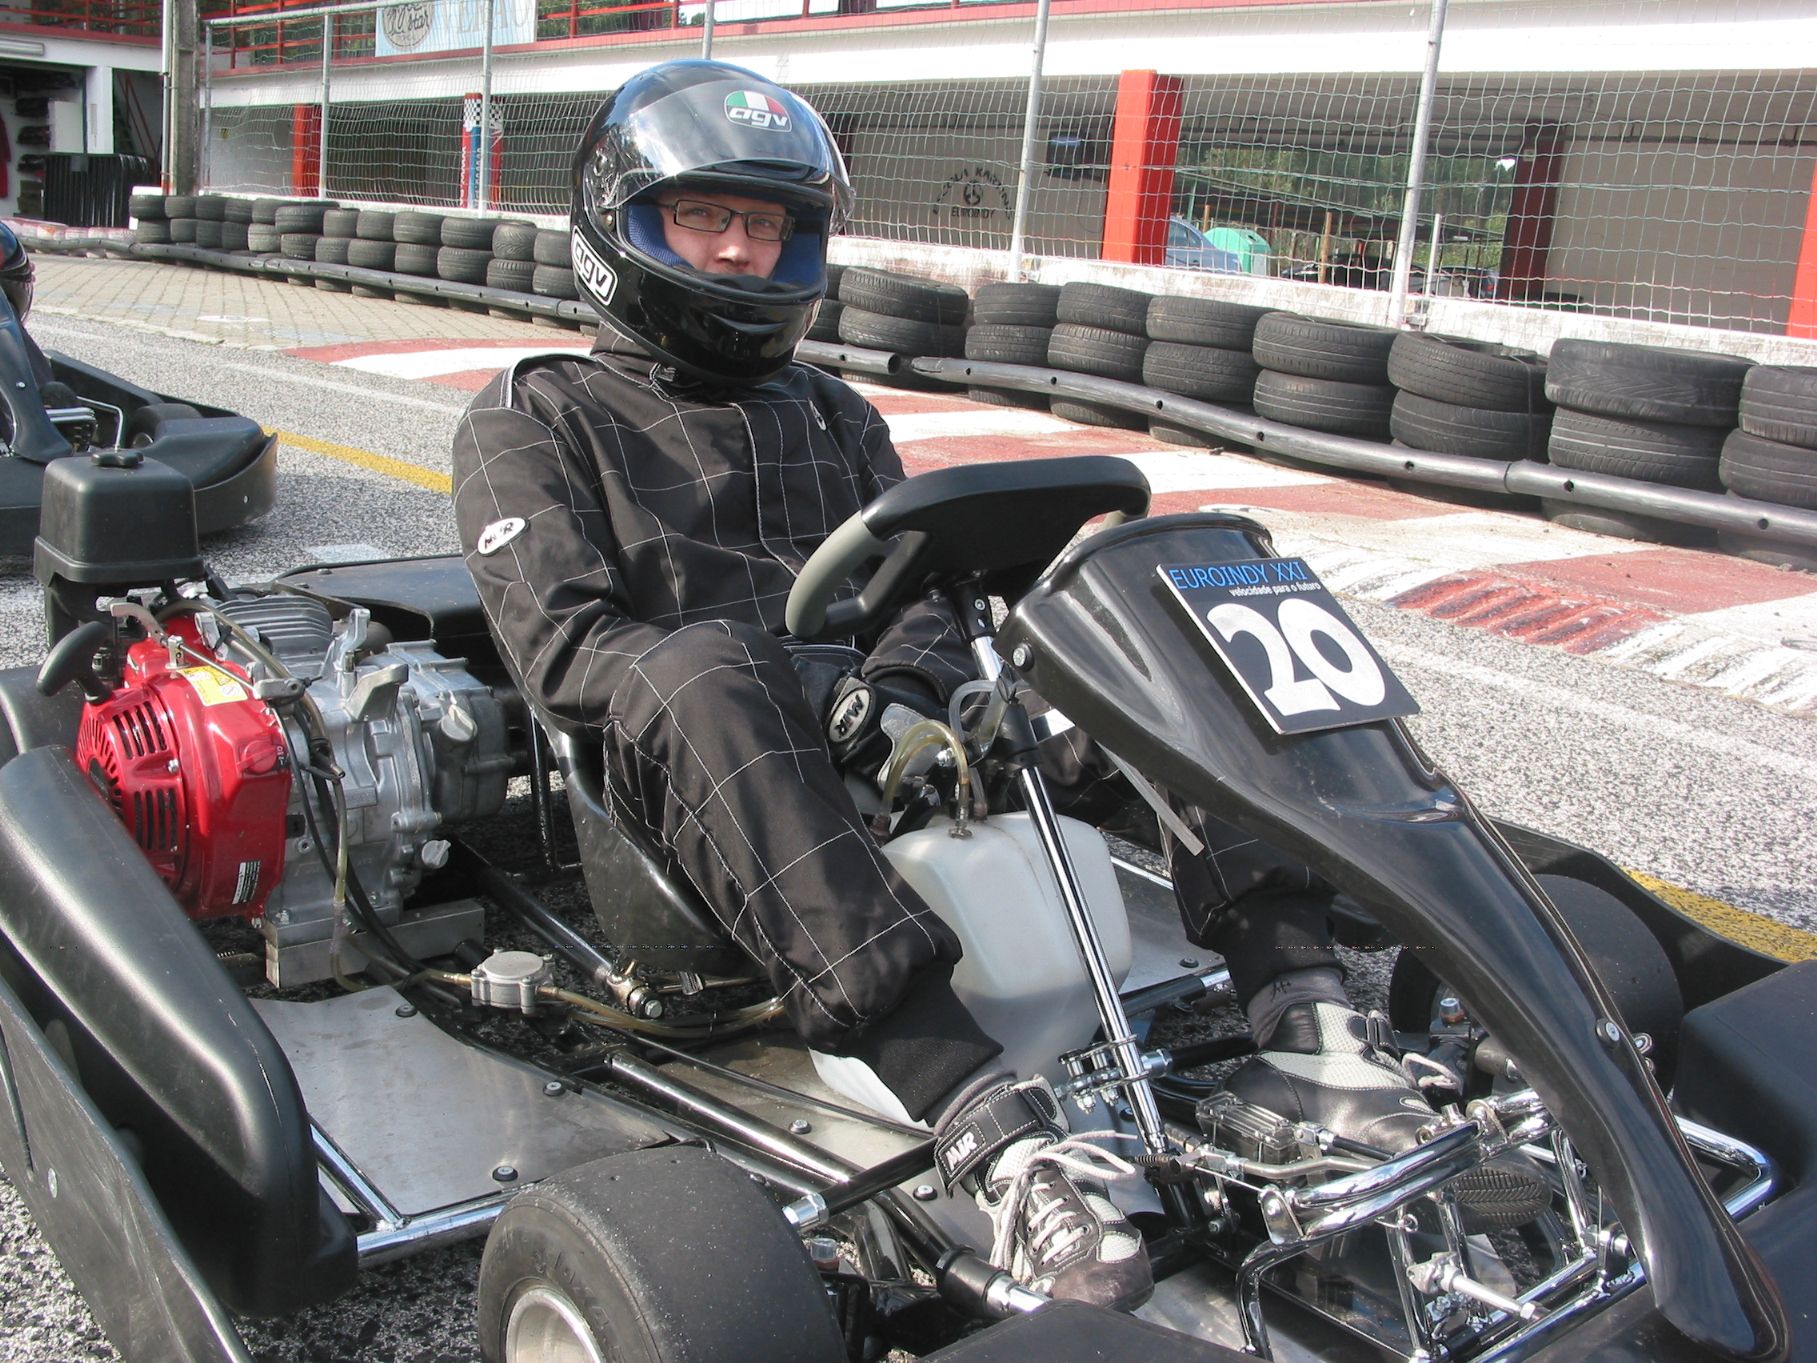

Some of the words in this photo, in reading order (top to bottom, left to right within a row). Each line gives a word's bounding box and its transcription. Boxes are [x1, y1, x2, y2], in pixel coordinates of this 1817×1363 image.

[729, 107, 788, 128] agv
[574, 241, 608, 288] agv
[1168, 564, 1269, 590] EUROINDY
[1269, 560, 1308, 582] XXI
[1229, 586, 1272, 596] velocidade
[1273, 585, 1290, 595] para
[1296, 581, 1322, 592] futuro
[1206, 598, 1386, 717] 20
